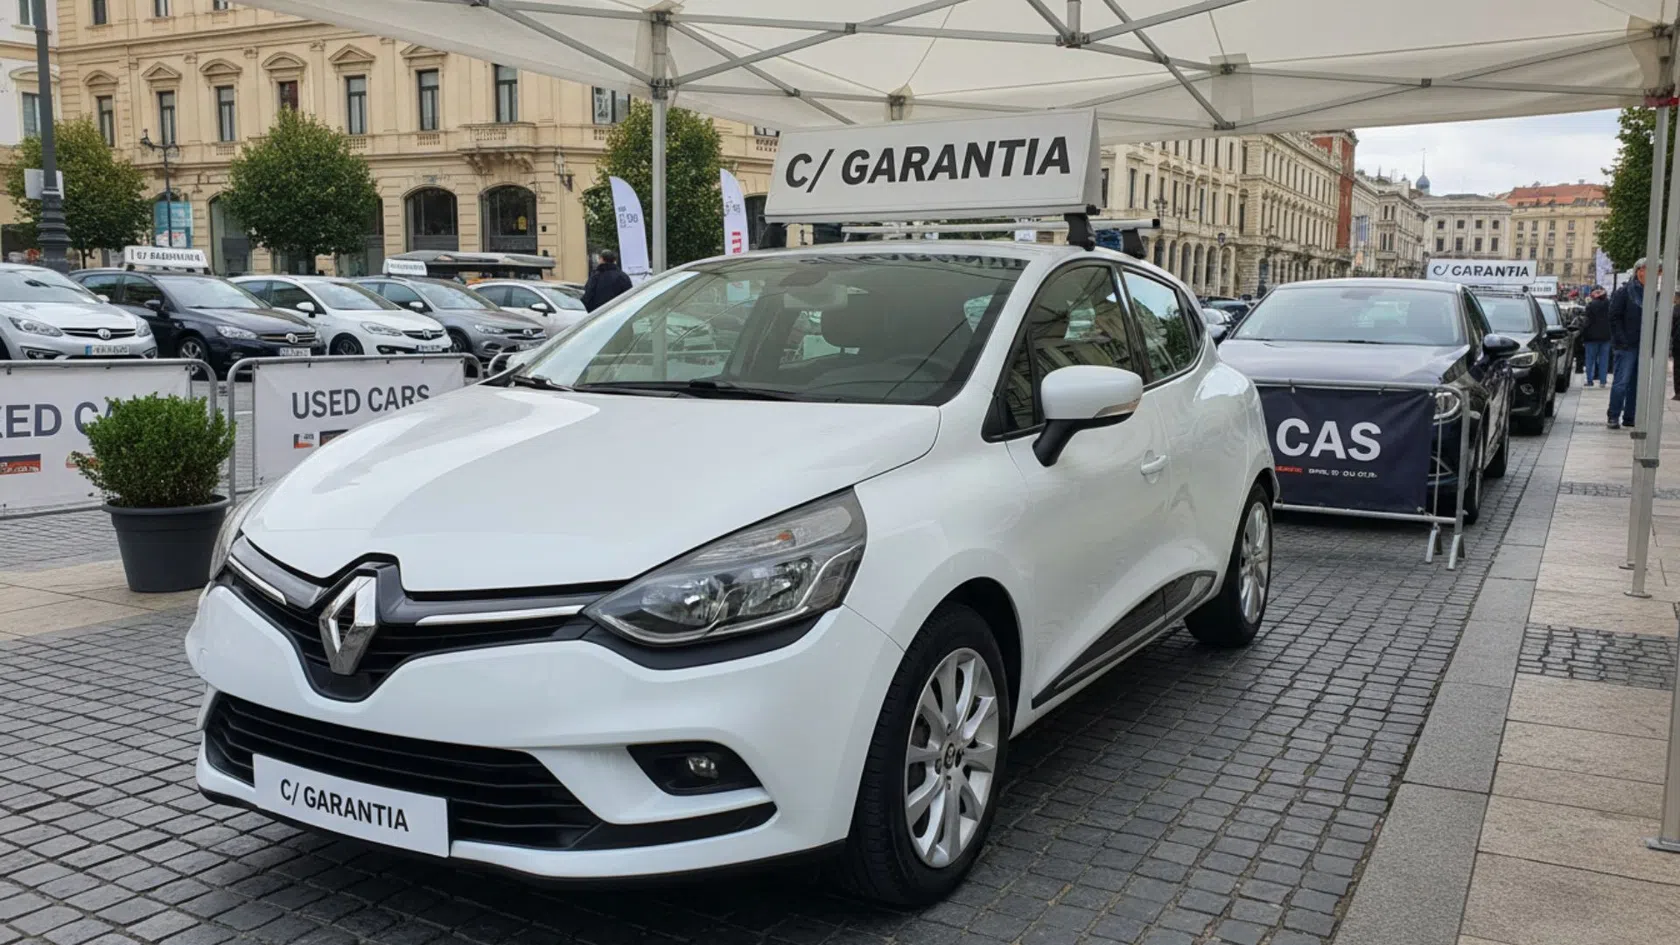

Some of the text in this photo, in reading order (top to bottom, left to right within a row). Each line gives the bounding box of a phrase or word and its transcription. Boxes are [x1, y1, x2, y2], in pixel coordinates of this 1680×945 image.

[785, 136, 1071, 193] C/ GARANTIA
[292, 384, 430, 420] USED CARS
[1275, 418, 1382, 462] CAS
[280, 779, 409, 832] C/ GARANTIA
